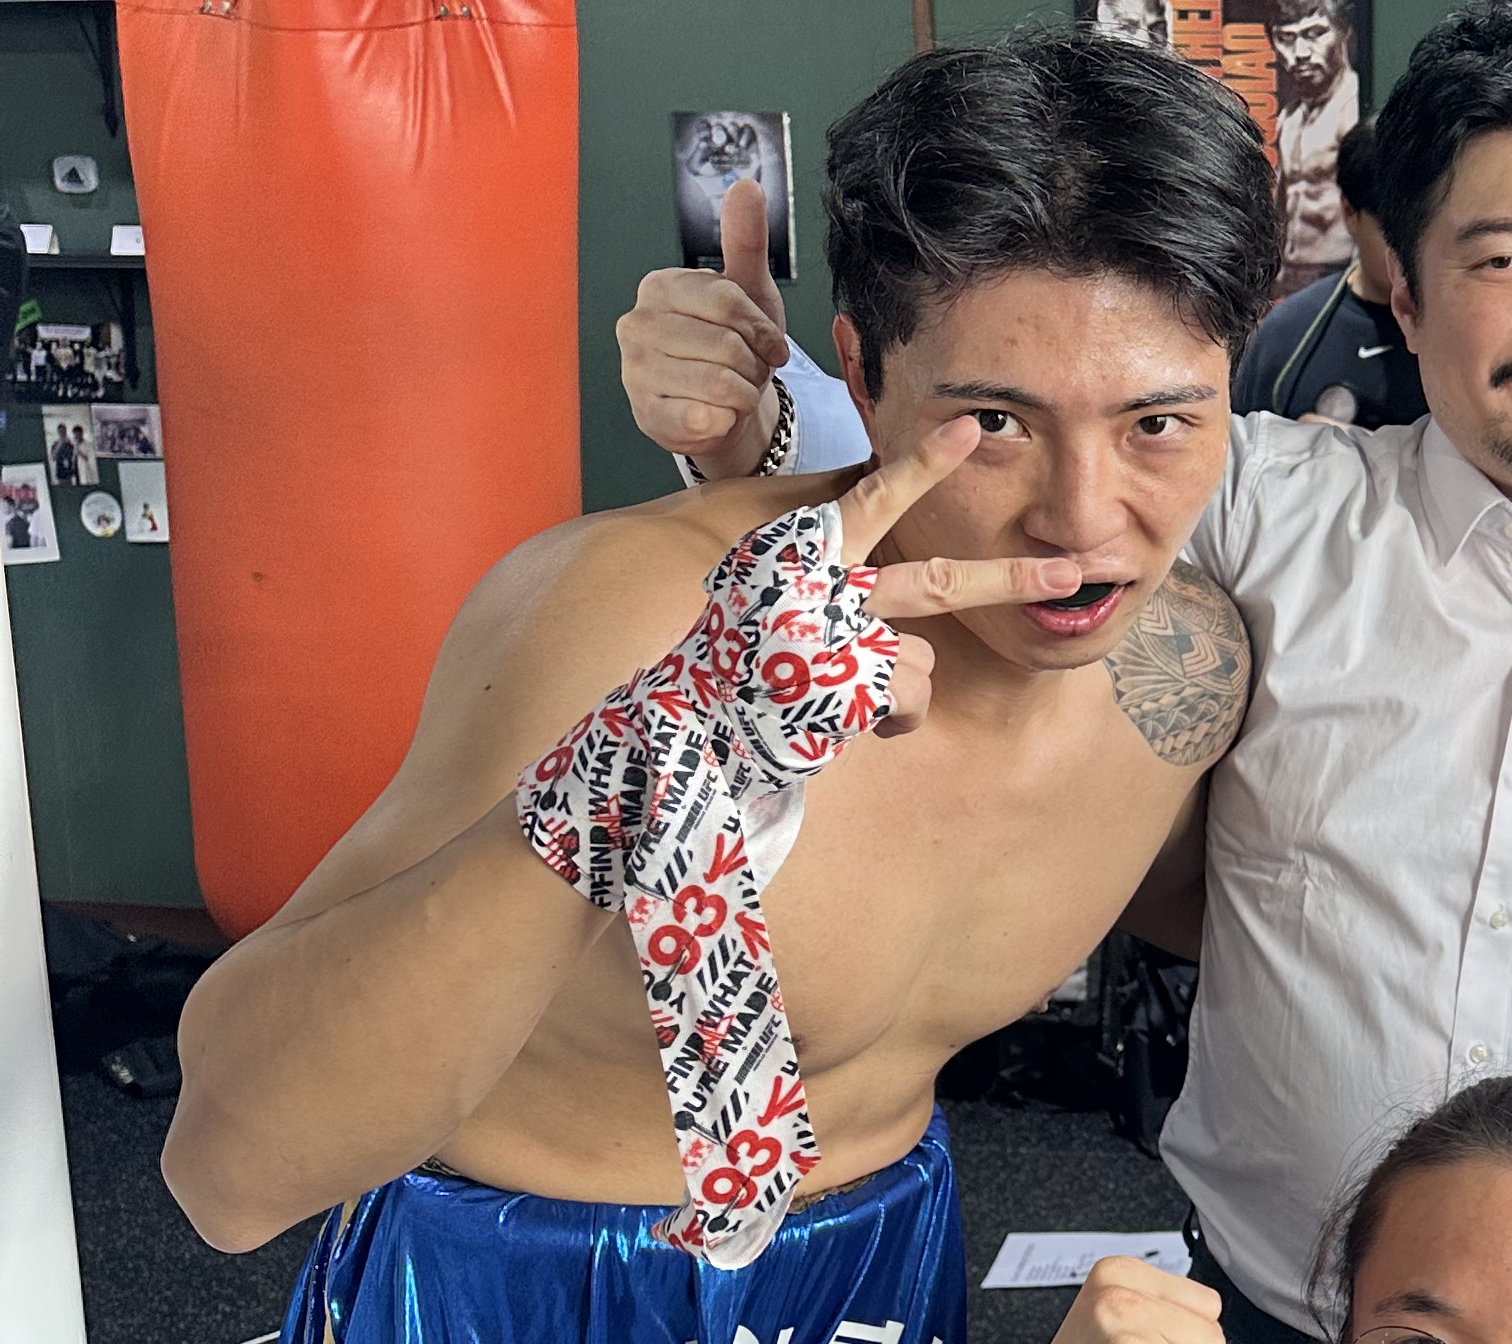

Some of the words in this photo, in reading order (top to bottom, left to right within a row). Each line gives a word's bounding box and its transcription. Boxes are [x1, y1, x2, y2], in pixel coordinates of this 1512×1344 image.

[588, 734, 622, 816] WHAT
[619, 745, 650, 829] MADE
[658, 728, 707, 816] MADE
[665, 1031, 706, 1094] FIND
[696, 951, 755, 1029] WHAT
[718, 971, 777, 1055] MADE
[758, 1014, 783, 1045] UFC
